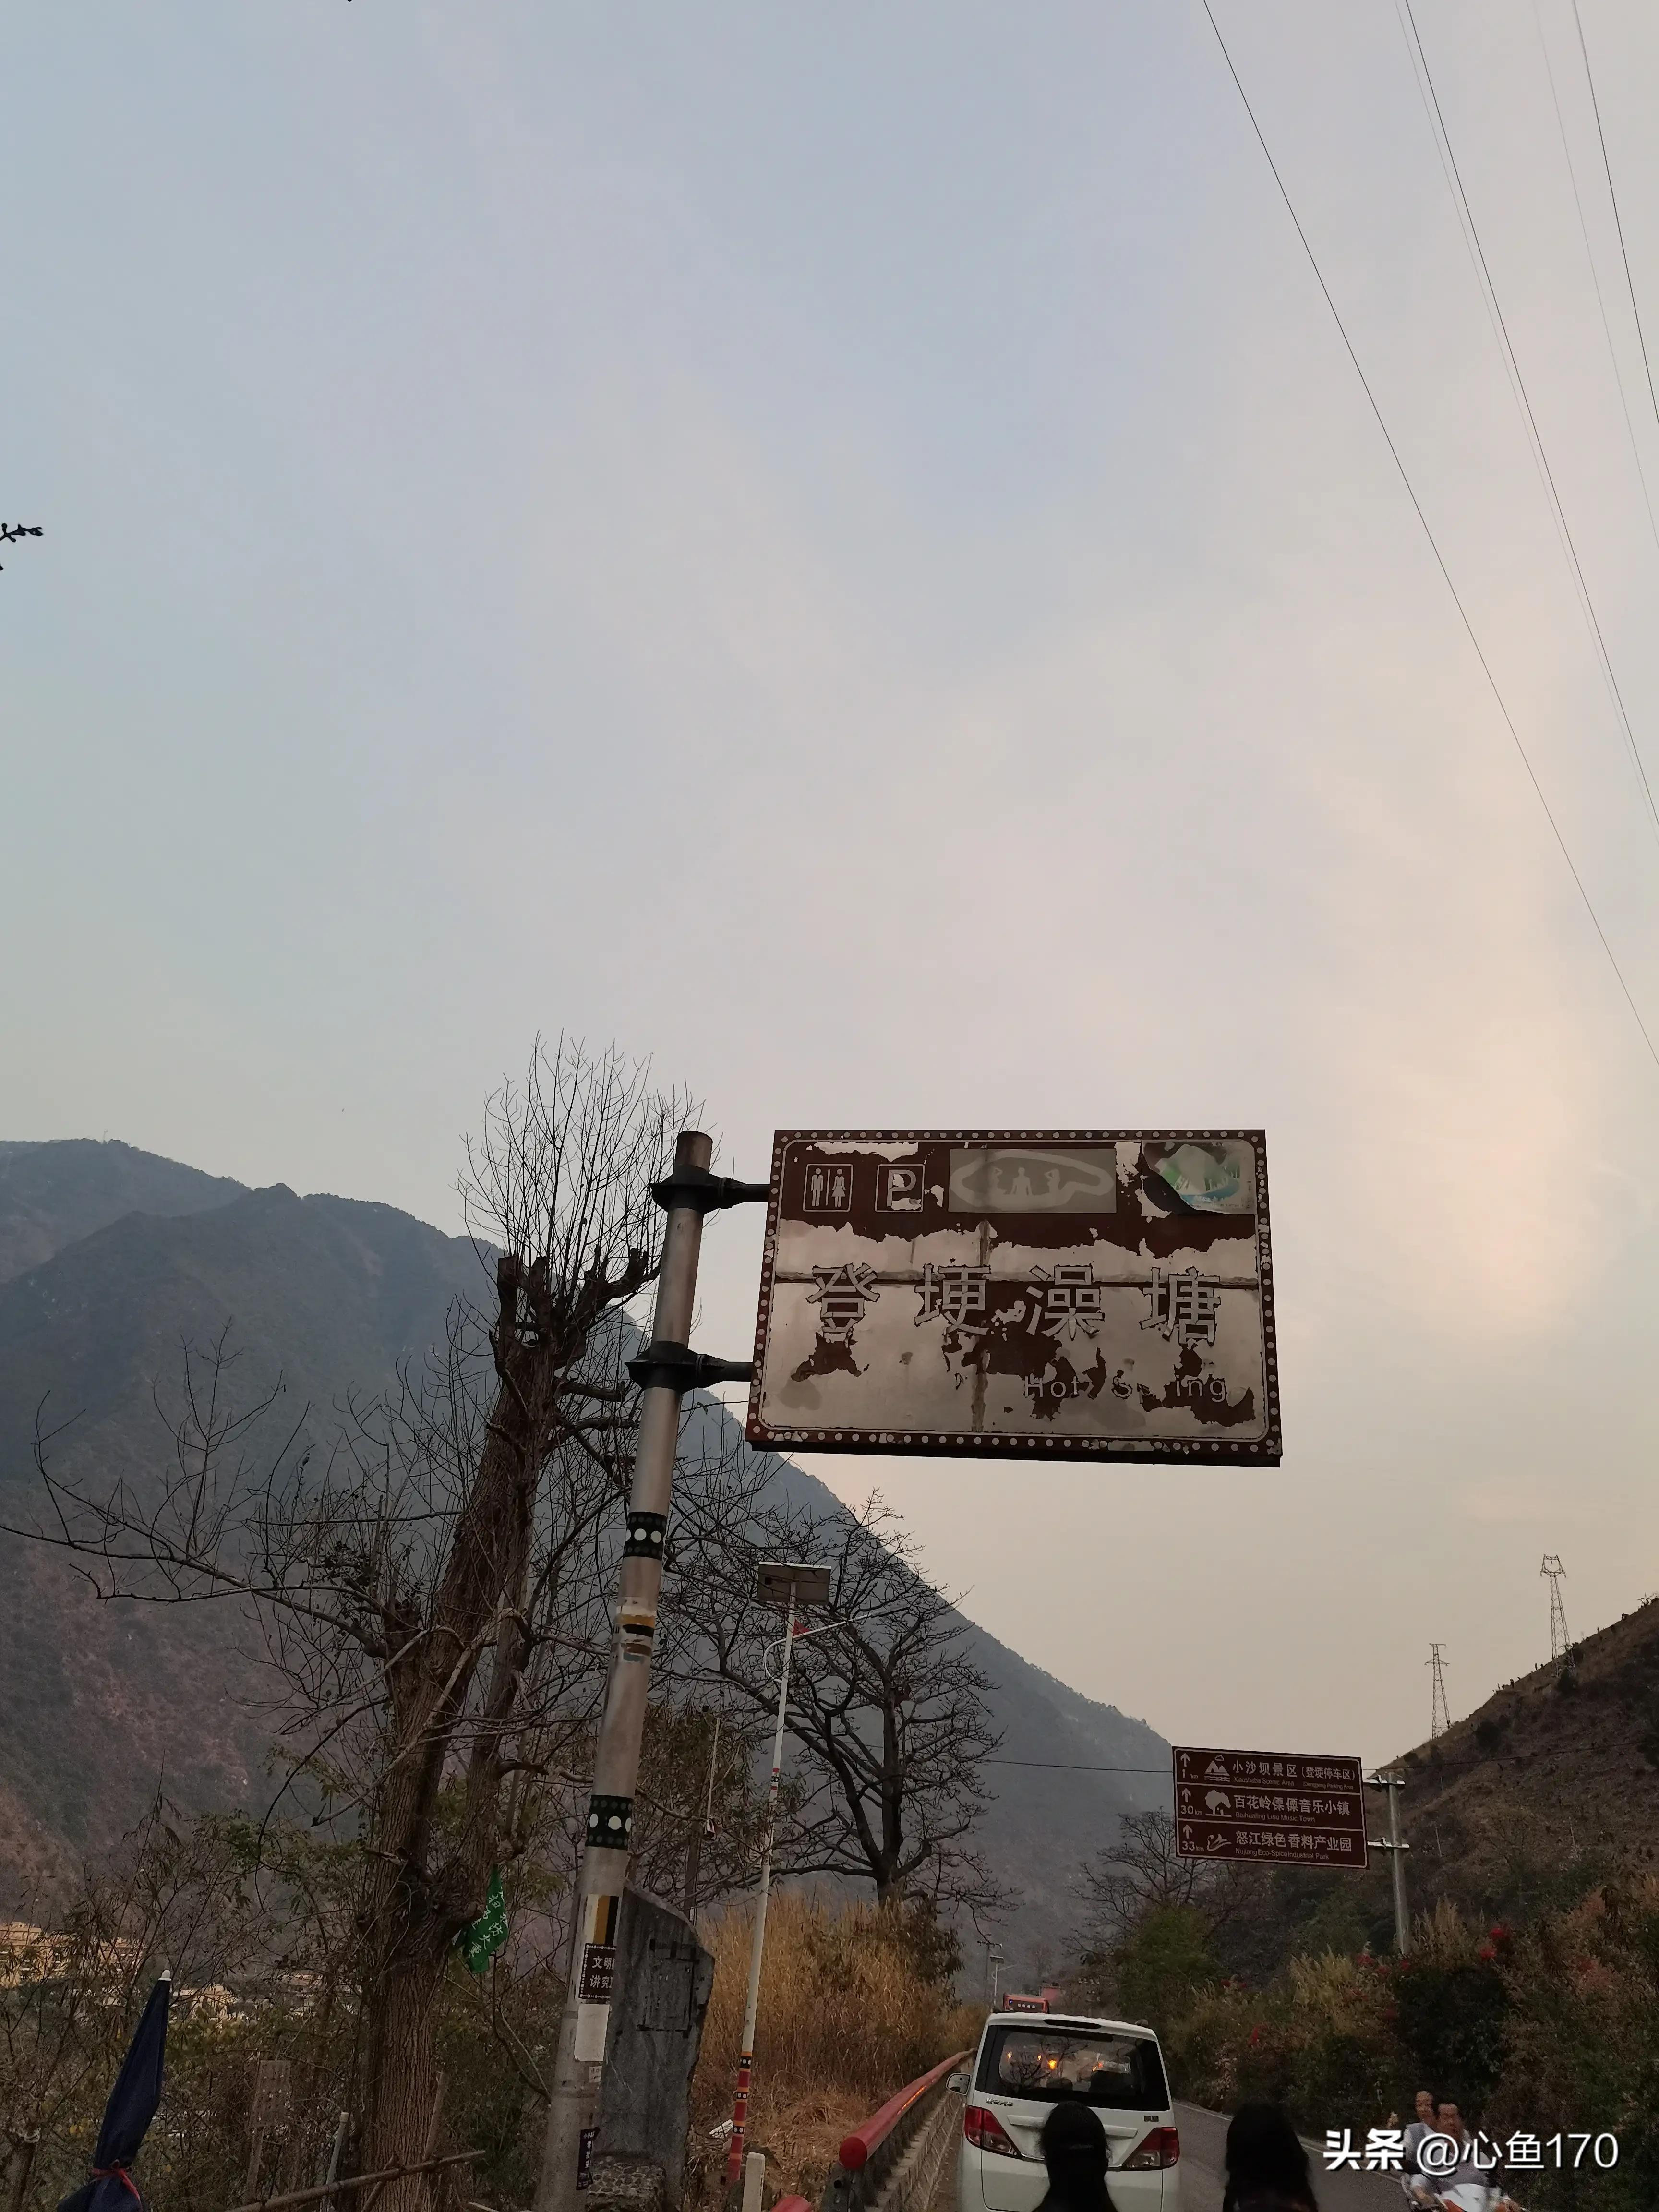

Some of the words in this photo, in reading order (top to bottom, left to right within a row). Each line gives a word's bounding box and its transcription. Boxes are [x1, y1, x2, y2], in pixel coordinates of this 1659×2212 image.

[887, 1169, 916, 1207] P
[805, 1263, 1222, 1346] 登埂澡塘
[1024, 1375, 1080, 1398] Hot
[1182, 1769, 1185, 1779] 1
[1232, 1760, 1297, 1777] 小沙坝景区
[1180, 1805, 1194, 1815] 30
[1234, 1795, 1350, 1815] 百花岭傈僳音乐小镇
[1182, 1840, 1195, 1851] 33
[1236, 1830, 1352, 1852] 怒江绿色香料产业园
